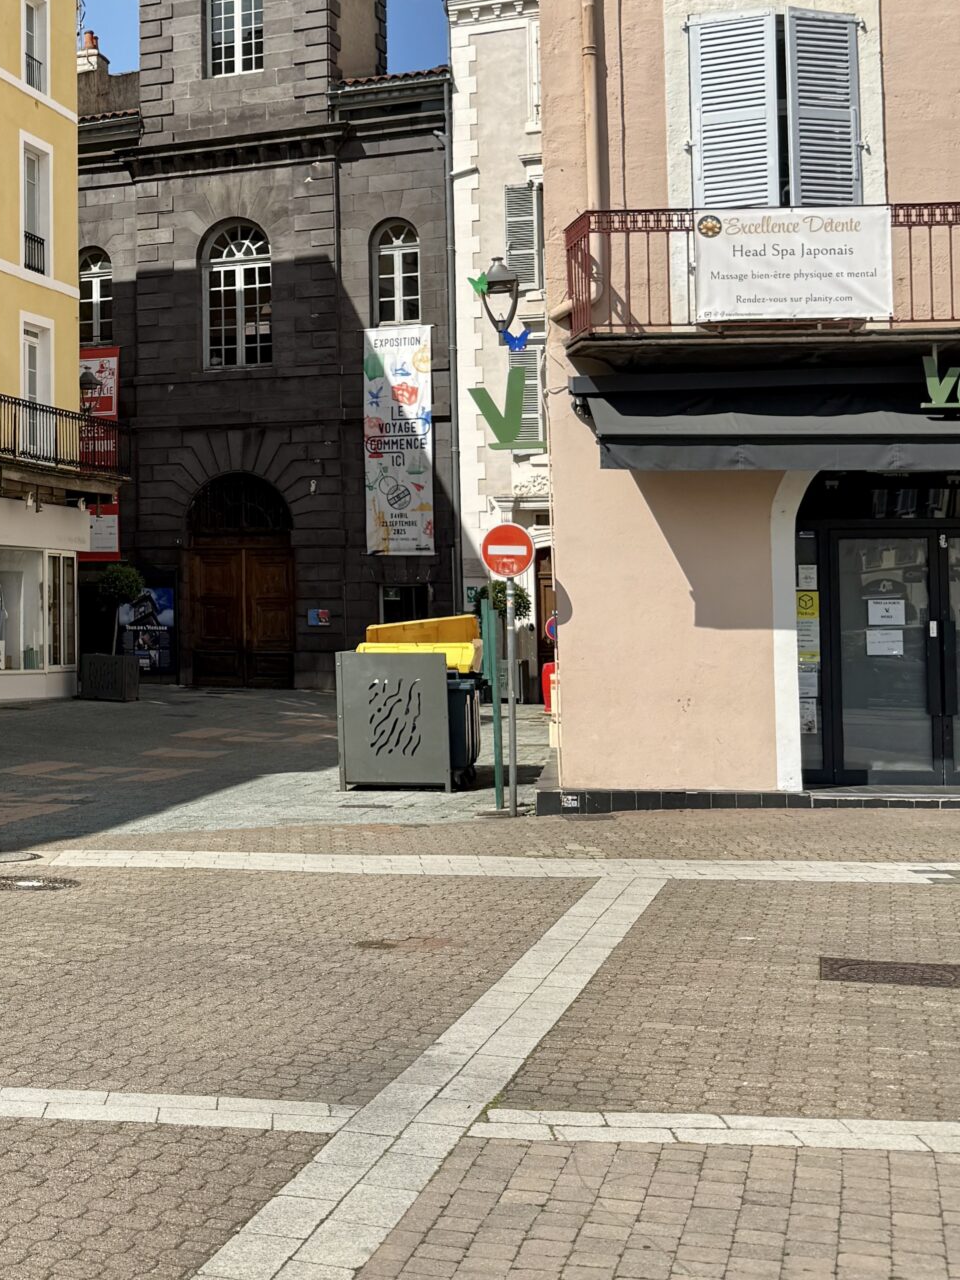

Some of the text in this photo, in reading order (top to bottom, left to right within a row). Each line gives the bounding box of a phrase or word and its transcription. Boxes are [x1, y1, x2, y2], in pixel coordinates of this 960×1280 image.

[723, 215, 800, 236] Excellence
[732, 243, 854, 259] Head Spa Japonais
[710, 267, 878, 283] Massage bien-être physique et mental
[735, 294, 853, 305] Rendez-vous sur planity.com
[373, 336, 421, 348] EXPOSITION
[921, 355, 960, 408] V
[390, 405, 404, 418] LE
[378, 421, 417, 434] VOYAGE
[369, 437, 426, 450] COMMENCE
[391, 455, 405, 467] ICI
